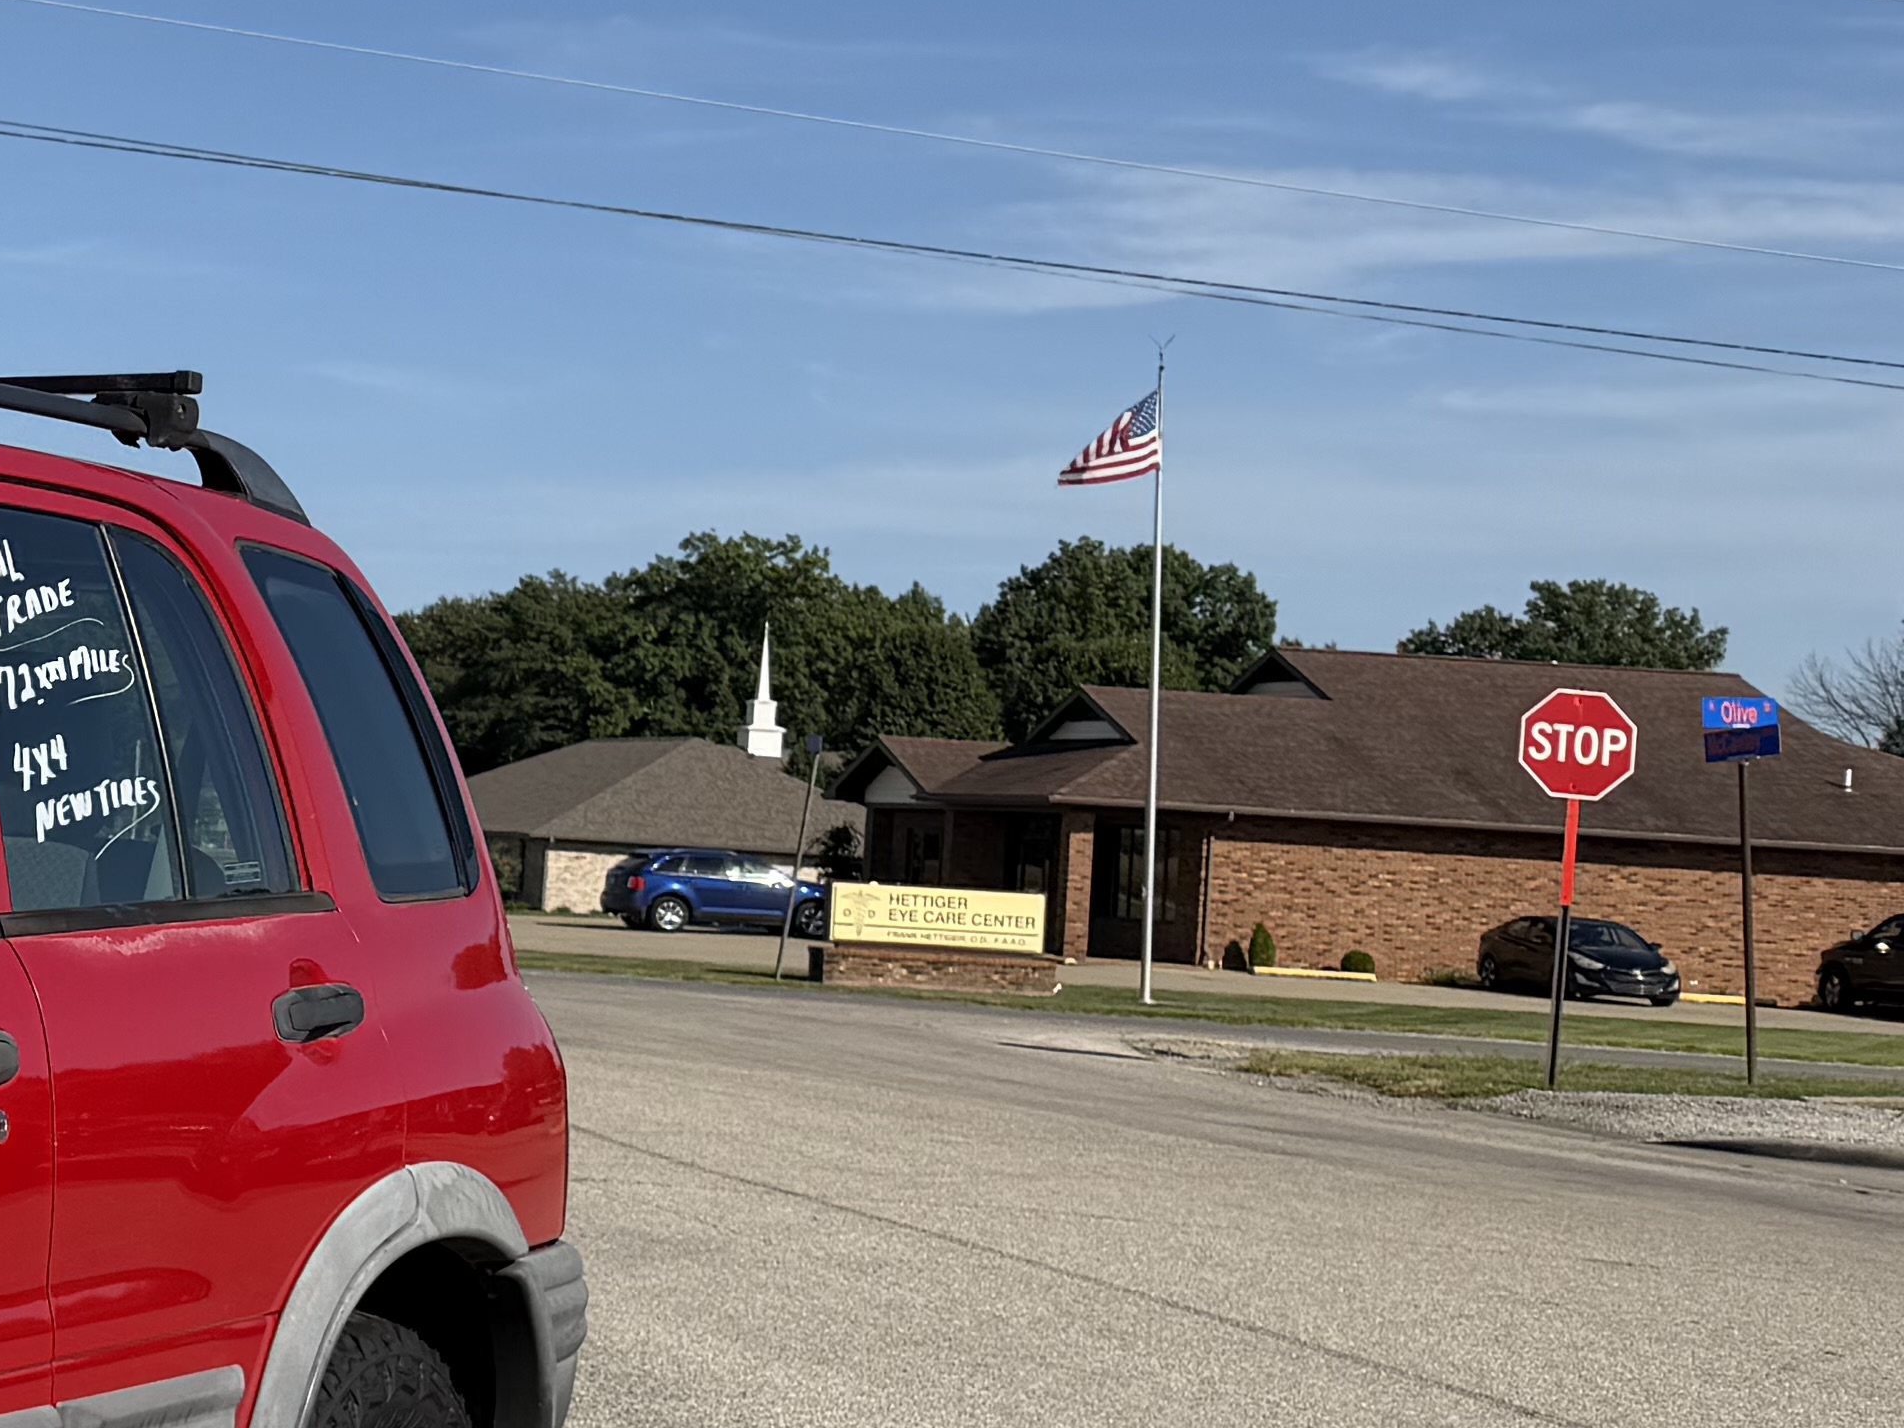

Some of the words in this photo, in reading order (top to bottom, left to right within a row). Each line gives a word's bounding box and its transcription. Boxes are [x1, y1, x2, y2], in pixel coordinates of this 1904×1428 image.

[69, 645, 135, 690] MILES
[1720, 700, 1758, 724] Olive
[1528, 721, 1627, 767] STOP
[36, 790, 92, 843] NEW
[94, 777, 160, 834] TIRES
[888, 893, 968, 910] HETTIGER
[888, 908, 919, 922] EYE
[923, 910, 967, 926] CARE
[971, 913, 1036, 929] CENTER
